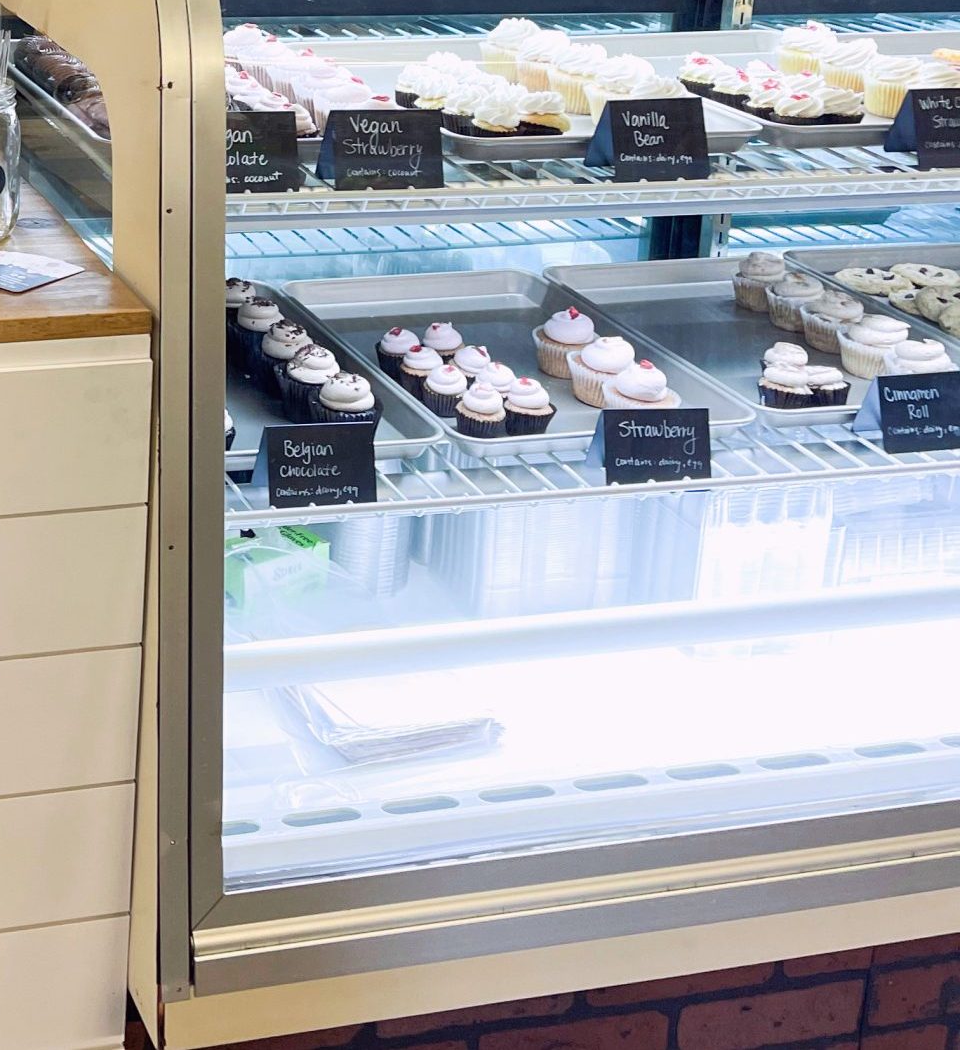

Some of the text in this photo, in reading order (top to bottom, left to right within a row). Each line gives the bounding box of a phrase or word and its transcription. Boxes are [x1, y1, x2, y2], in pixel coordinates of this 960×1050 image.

[919, 95, 953, 110] White
[622, 110, 670, 129] Vanilla
[349, 116, 402, 144] Vegan
[633, 130, 664, 147] Bean
[225, 129, 253, 150] gan
[225, 151, 269, 167] olate
[342, 139, 423, 169] Strawberry
[244, 171, 283, 183] coconut
[883, 386, 940, 402] Cinnamon
[907, 404, 929, 420] Roll
[618, 420, 700, 455] Strawberry
[283, 440, 333, 464] Belgian
